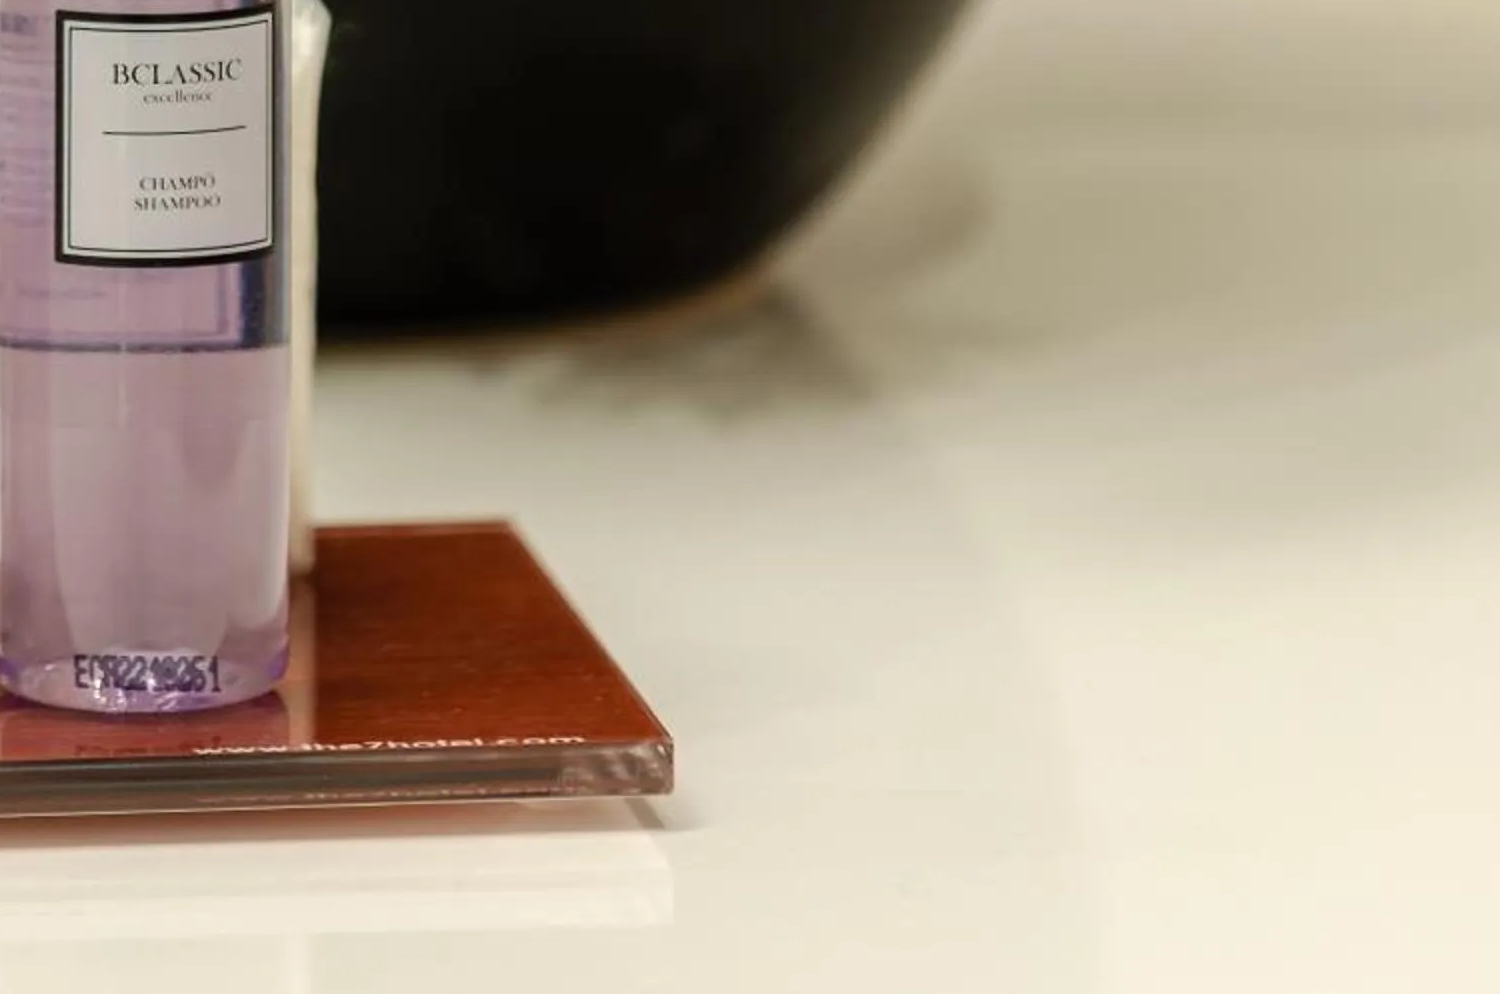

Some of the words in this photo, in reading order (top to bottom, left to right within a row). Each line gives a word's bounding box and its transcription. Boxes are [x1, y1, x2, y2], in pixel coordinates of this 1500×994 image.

[113, 59, 242, 86] BCLASSIC
[143, 89, 212, 104] excellence
[134, 195, 220, 211] SHAMPOO
